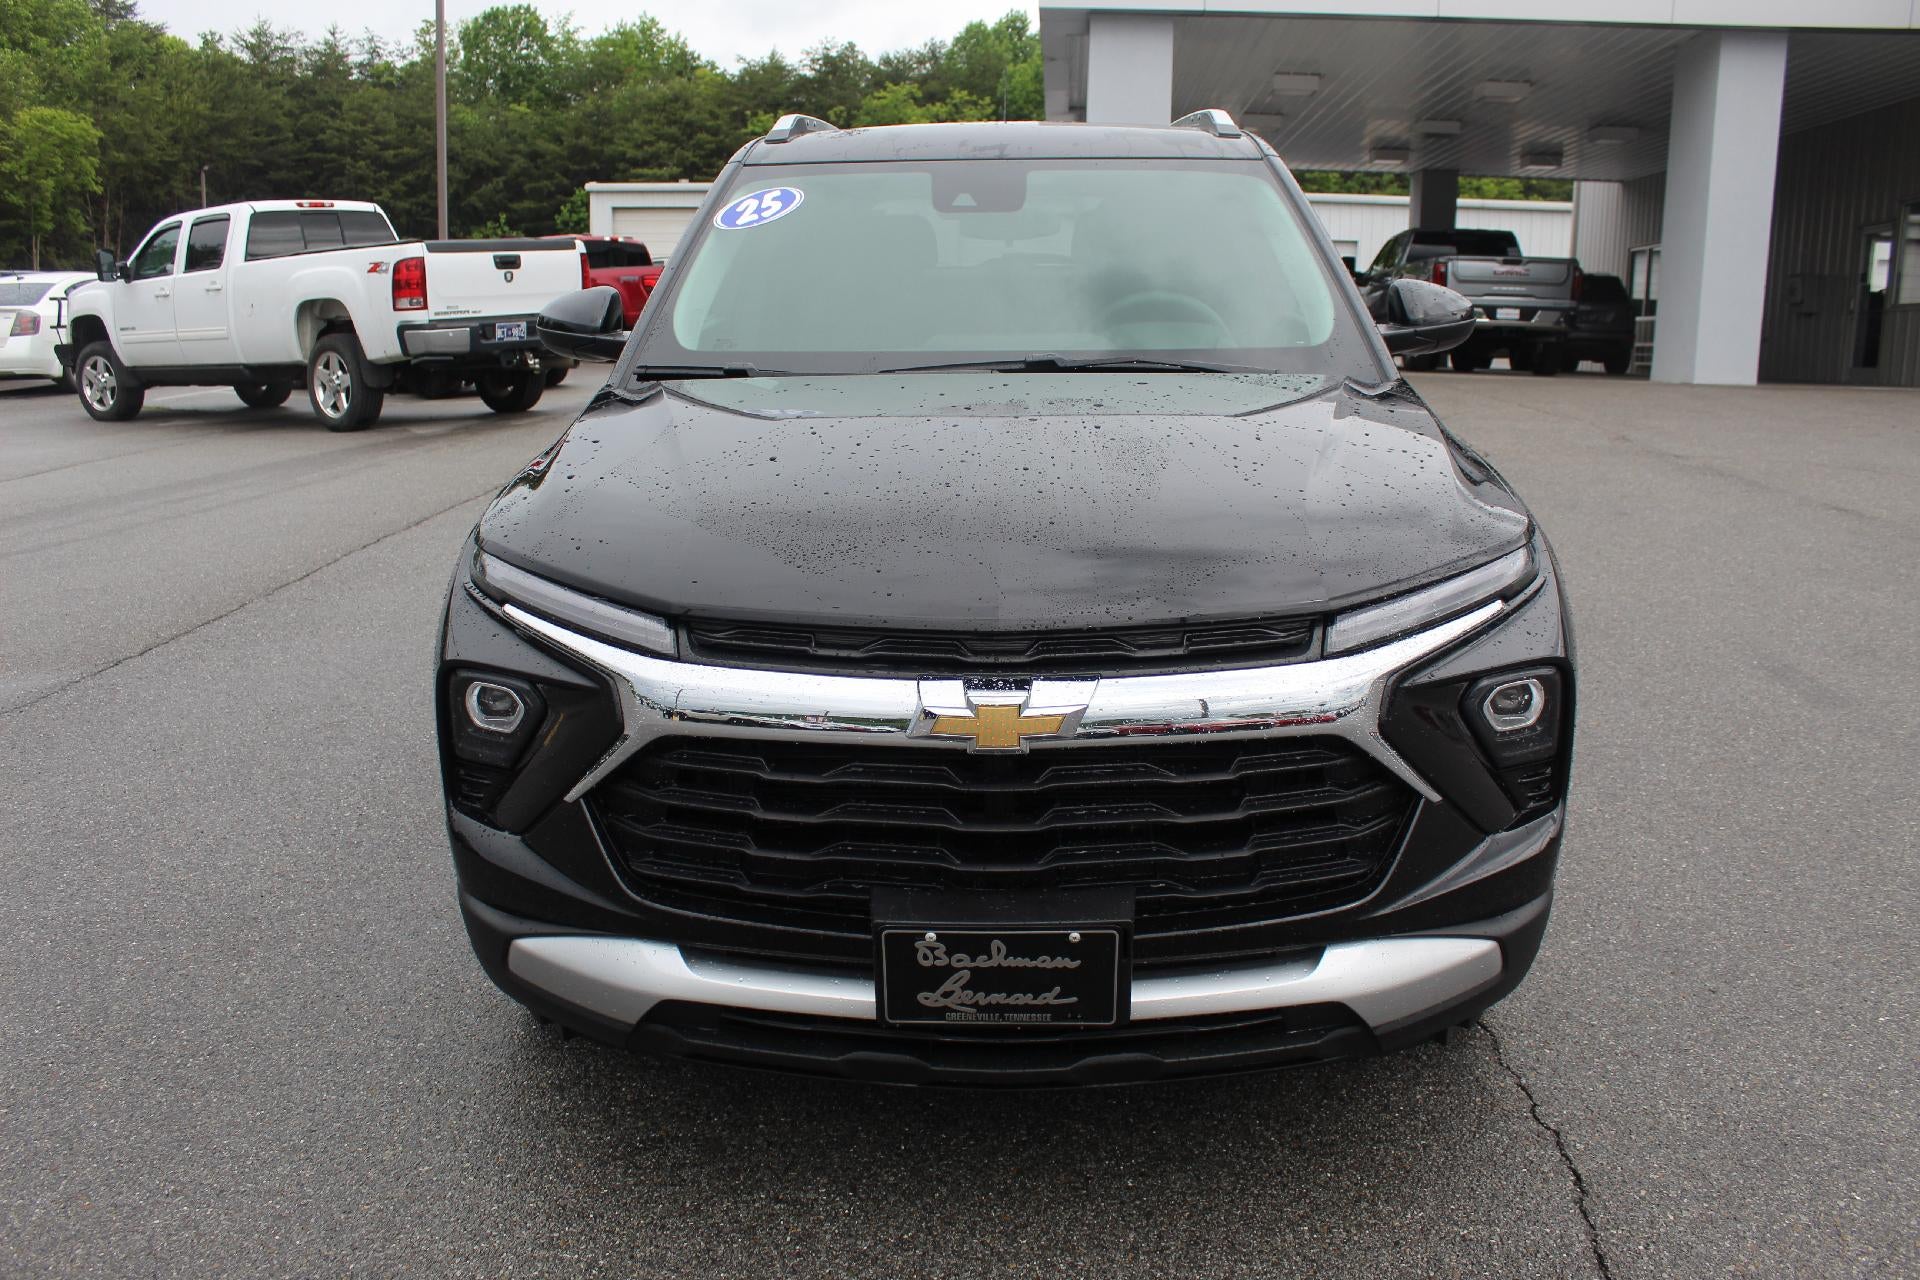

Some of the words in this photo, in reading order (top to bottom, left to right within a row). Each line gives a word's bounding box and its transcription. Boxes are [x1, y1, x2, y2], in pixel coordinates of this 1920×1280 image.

[735, 189, 783, 226] 25
[914, 939, 1081, 969] Bachman
[916, 969, 1079, 1012] Bernard
[945, 1012, 1003, 1022] GREENEVILLE,
[1004, 1013, 1052, 1023] TENNESSEE
